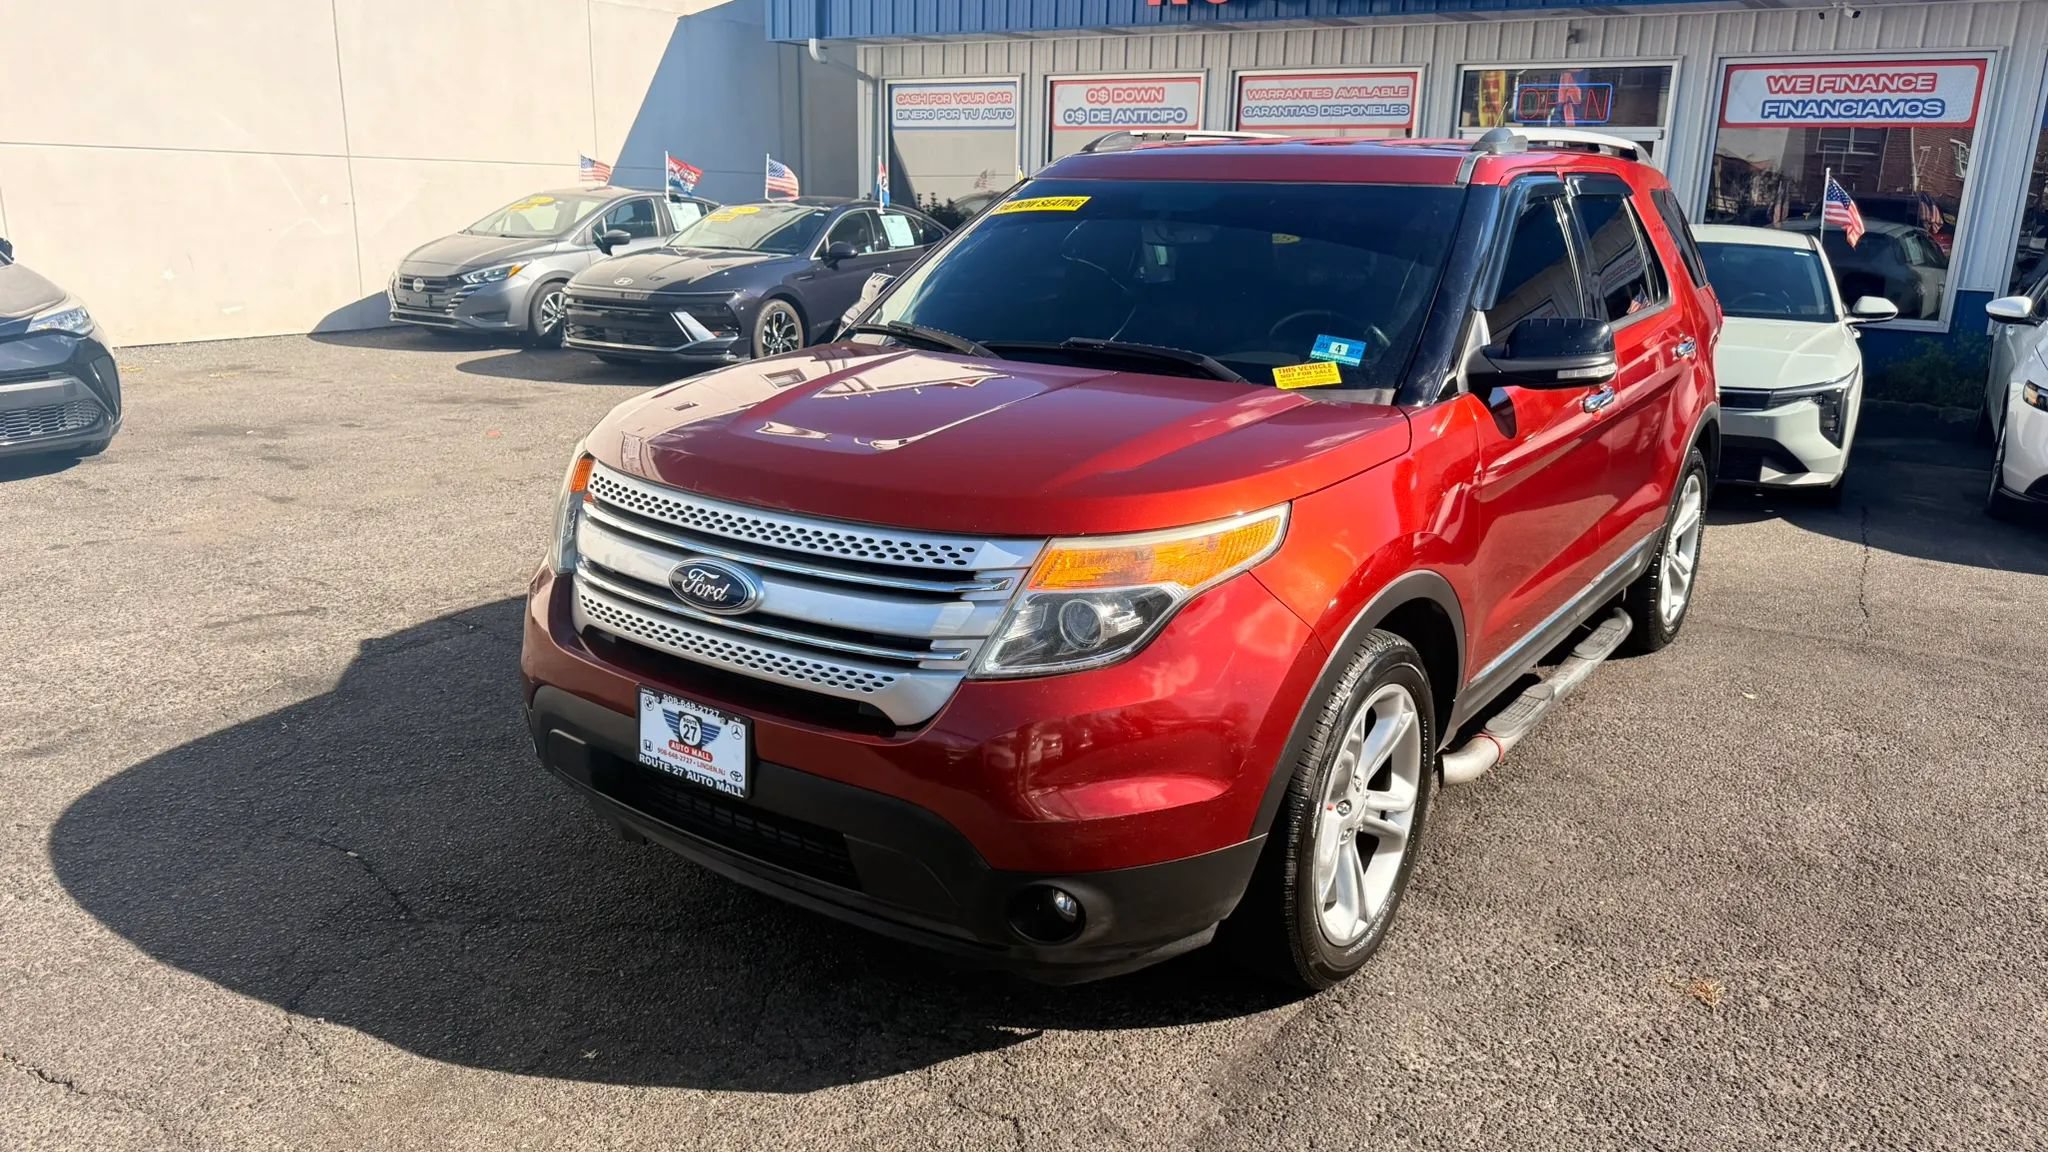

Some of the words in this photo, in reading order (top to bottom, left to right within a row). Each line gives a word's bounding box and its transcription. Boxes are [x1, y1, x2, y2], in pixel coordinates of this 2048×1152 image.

[1768, 76, 1813, 93] WE
[1818, 74, 1936, 92] FINANCE
[896, 94, 926, 105] CASH
[929, 93, 951, 105] FOR
[953, 92, 985, 104] YOUR
[987, 92, 1012, 104] CAR
[1086, 87, 1110, 104] 0$
[1112, 87, 1164, 102] DOWN
[1247, 87, 1332, 100] WARRANTIES
[1335, 86, 1408, 98] AVAILABLE
[1243, 105, 1317, 117] GARANTIAS
[1320, 104, 1409, 116] DISPONIBLES
[1519, 88, 1609, 119] OPN
[1763, 100, 1943, 117] FINANCIAMOS
[896, 109, 935, 120] DINERO
[937, 109, 960, 120] POR
[961, 108, 979, 120] TU
[981, 108, 1014, 120] AUTO
[1063, 107, 1086, 124] 0$
[1089, 109, 1111, 122] DE
[1112, 108, 1187, 123] ANTICIPO
[1334, 343, 1342, 353] 4
[1299, 363, 1333, 371] VEHICLE
[1315, 368, 1333, 376] SALE
[682, 568, 731, 602] Ford
[683, 724, 698, 742] 27
[670, 741, 690, 753] AUTO
[691, 748, 711, 761] MALL
[639, 753, 671, 773] ROUTE
[672, 765, 685, 777] 27
[686, 770, 714, 788] AUTO
[716, 780, 745, 799] MALL
